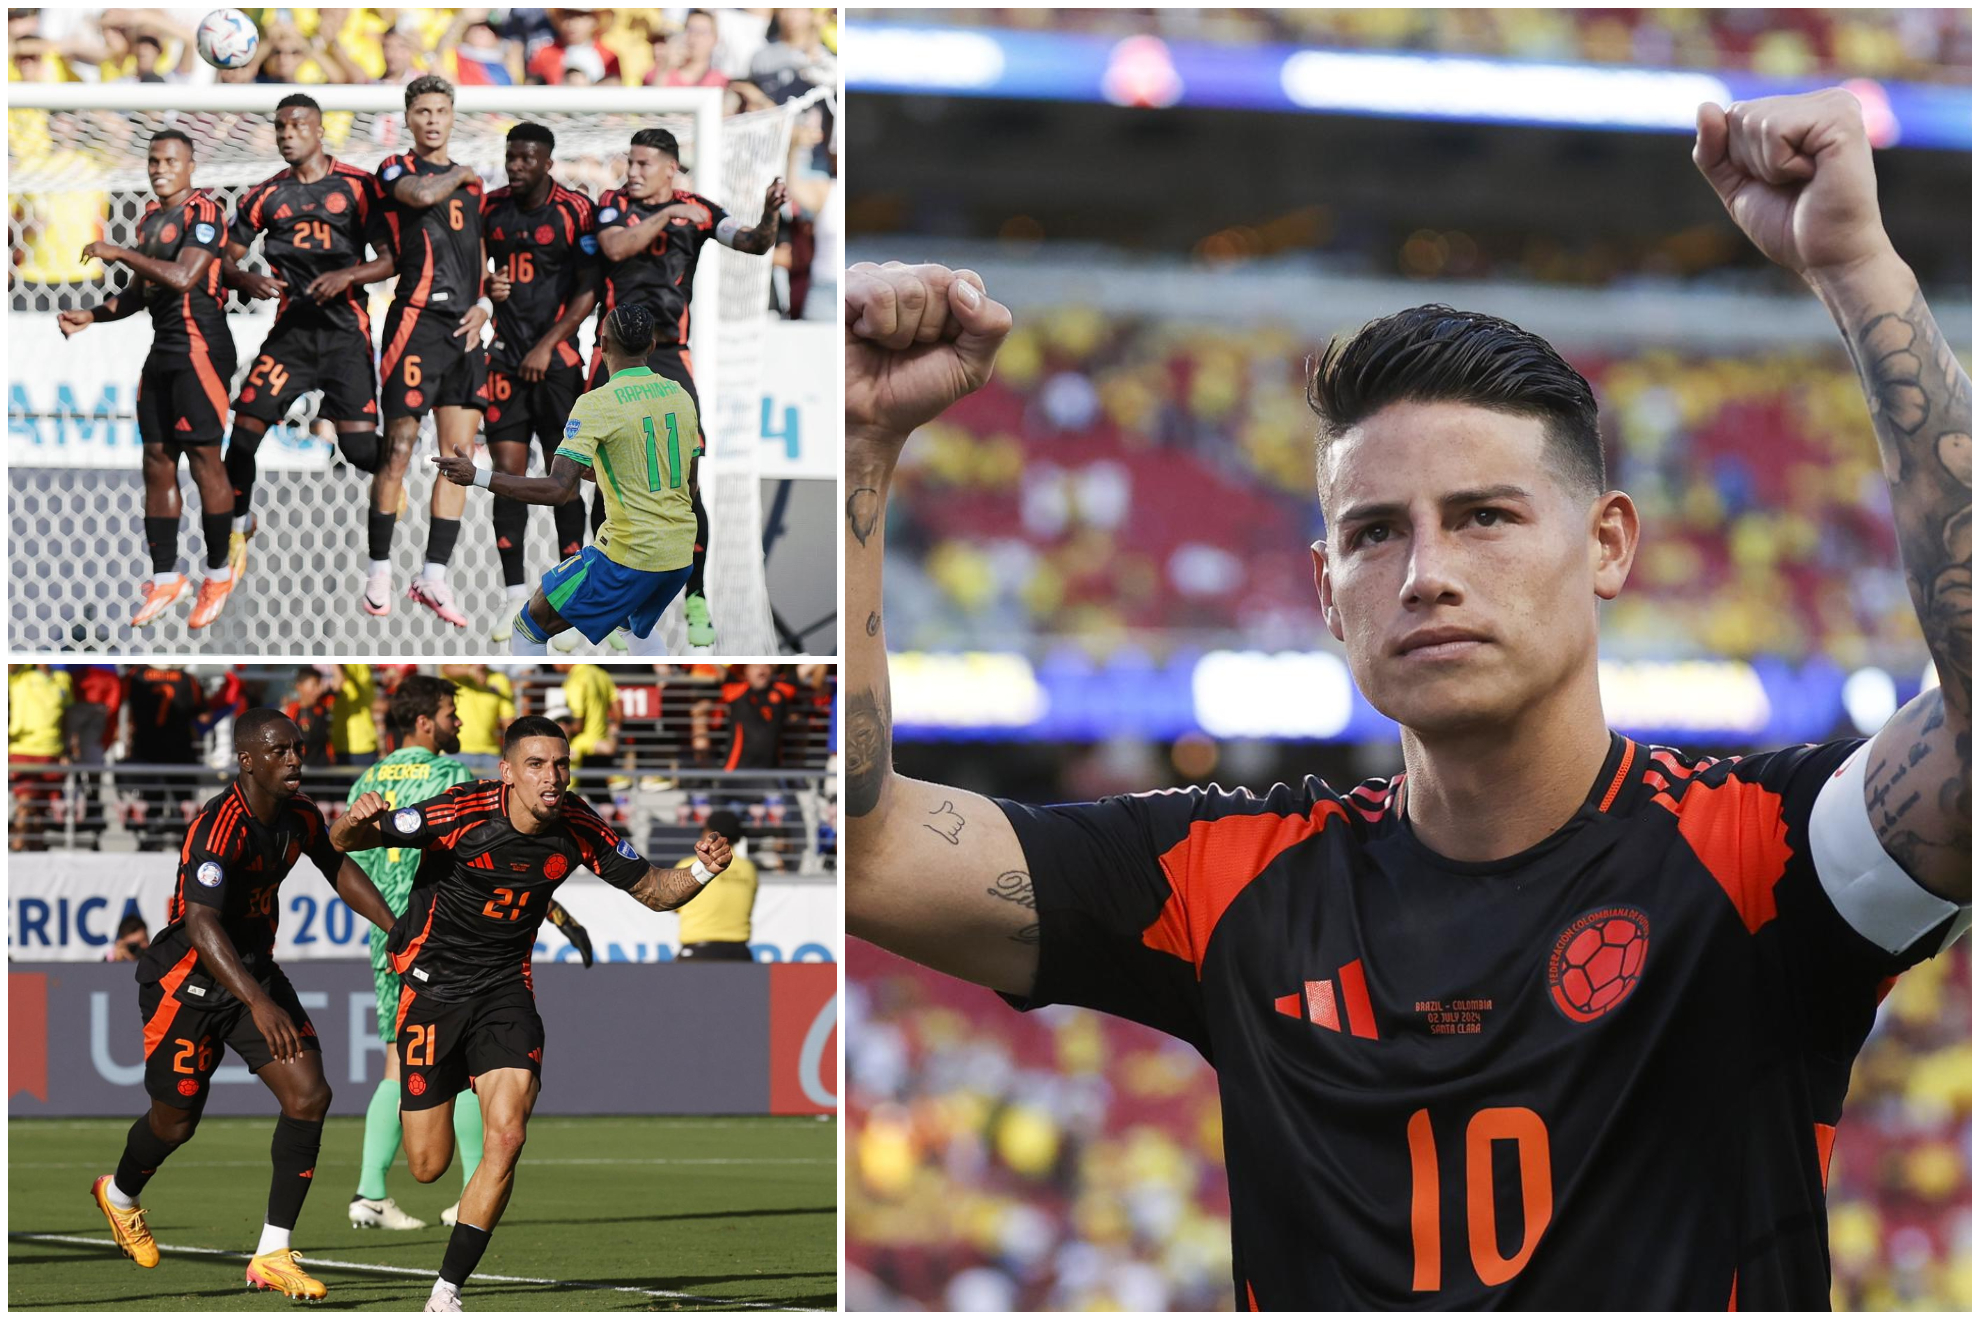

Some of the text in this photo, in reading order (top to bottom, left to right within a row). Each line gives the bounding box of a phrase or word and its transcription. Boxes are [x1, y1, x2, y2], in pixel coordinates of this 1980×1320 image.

[449, 199, 464, 231] 6
[293, 221, 331, 250] 24
[509, 251, 534, 284] 16
[249, 355, 289, 397] 24
[404, 355, 422, 387] 6
[487, 370, 511, 402] 16
[614, 380, 682, 404] RAPHINHA
[642, 412, 681, 493] 11
[377, 764, 431, 781] BECKER
[482, 888, 530, 920] 21
[1415, 1001, 1443, 1012] BRAZIL
[1452, 1000, 1493, 1010] COLOMBIA
[1427, 1011, 1480, 1023] 02 JULY 2024
[1430, 1023, 1481, 1034] SANTA CLARA
[174, 1035, 213, 1074] 26
[406, 1024, 436, 1066] 21
[1407, 1106, 1553, 1291] 10
